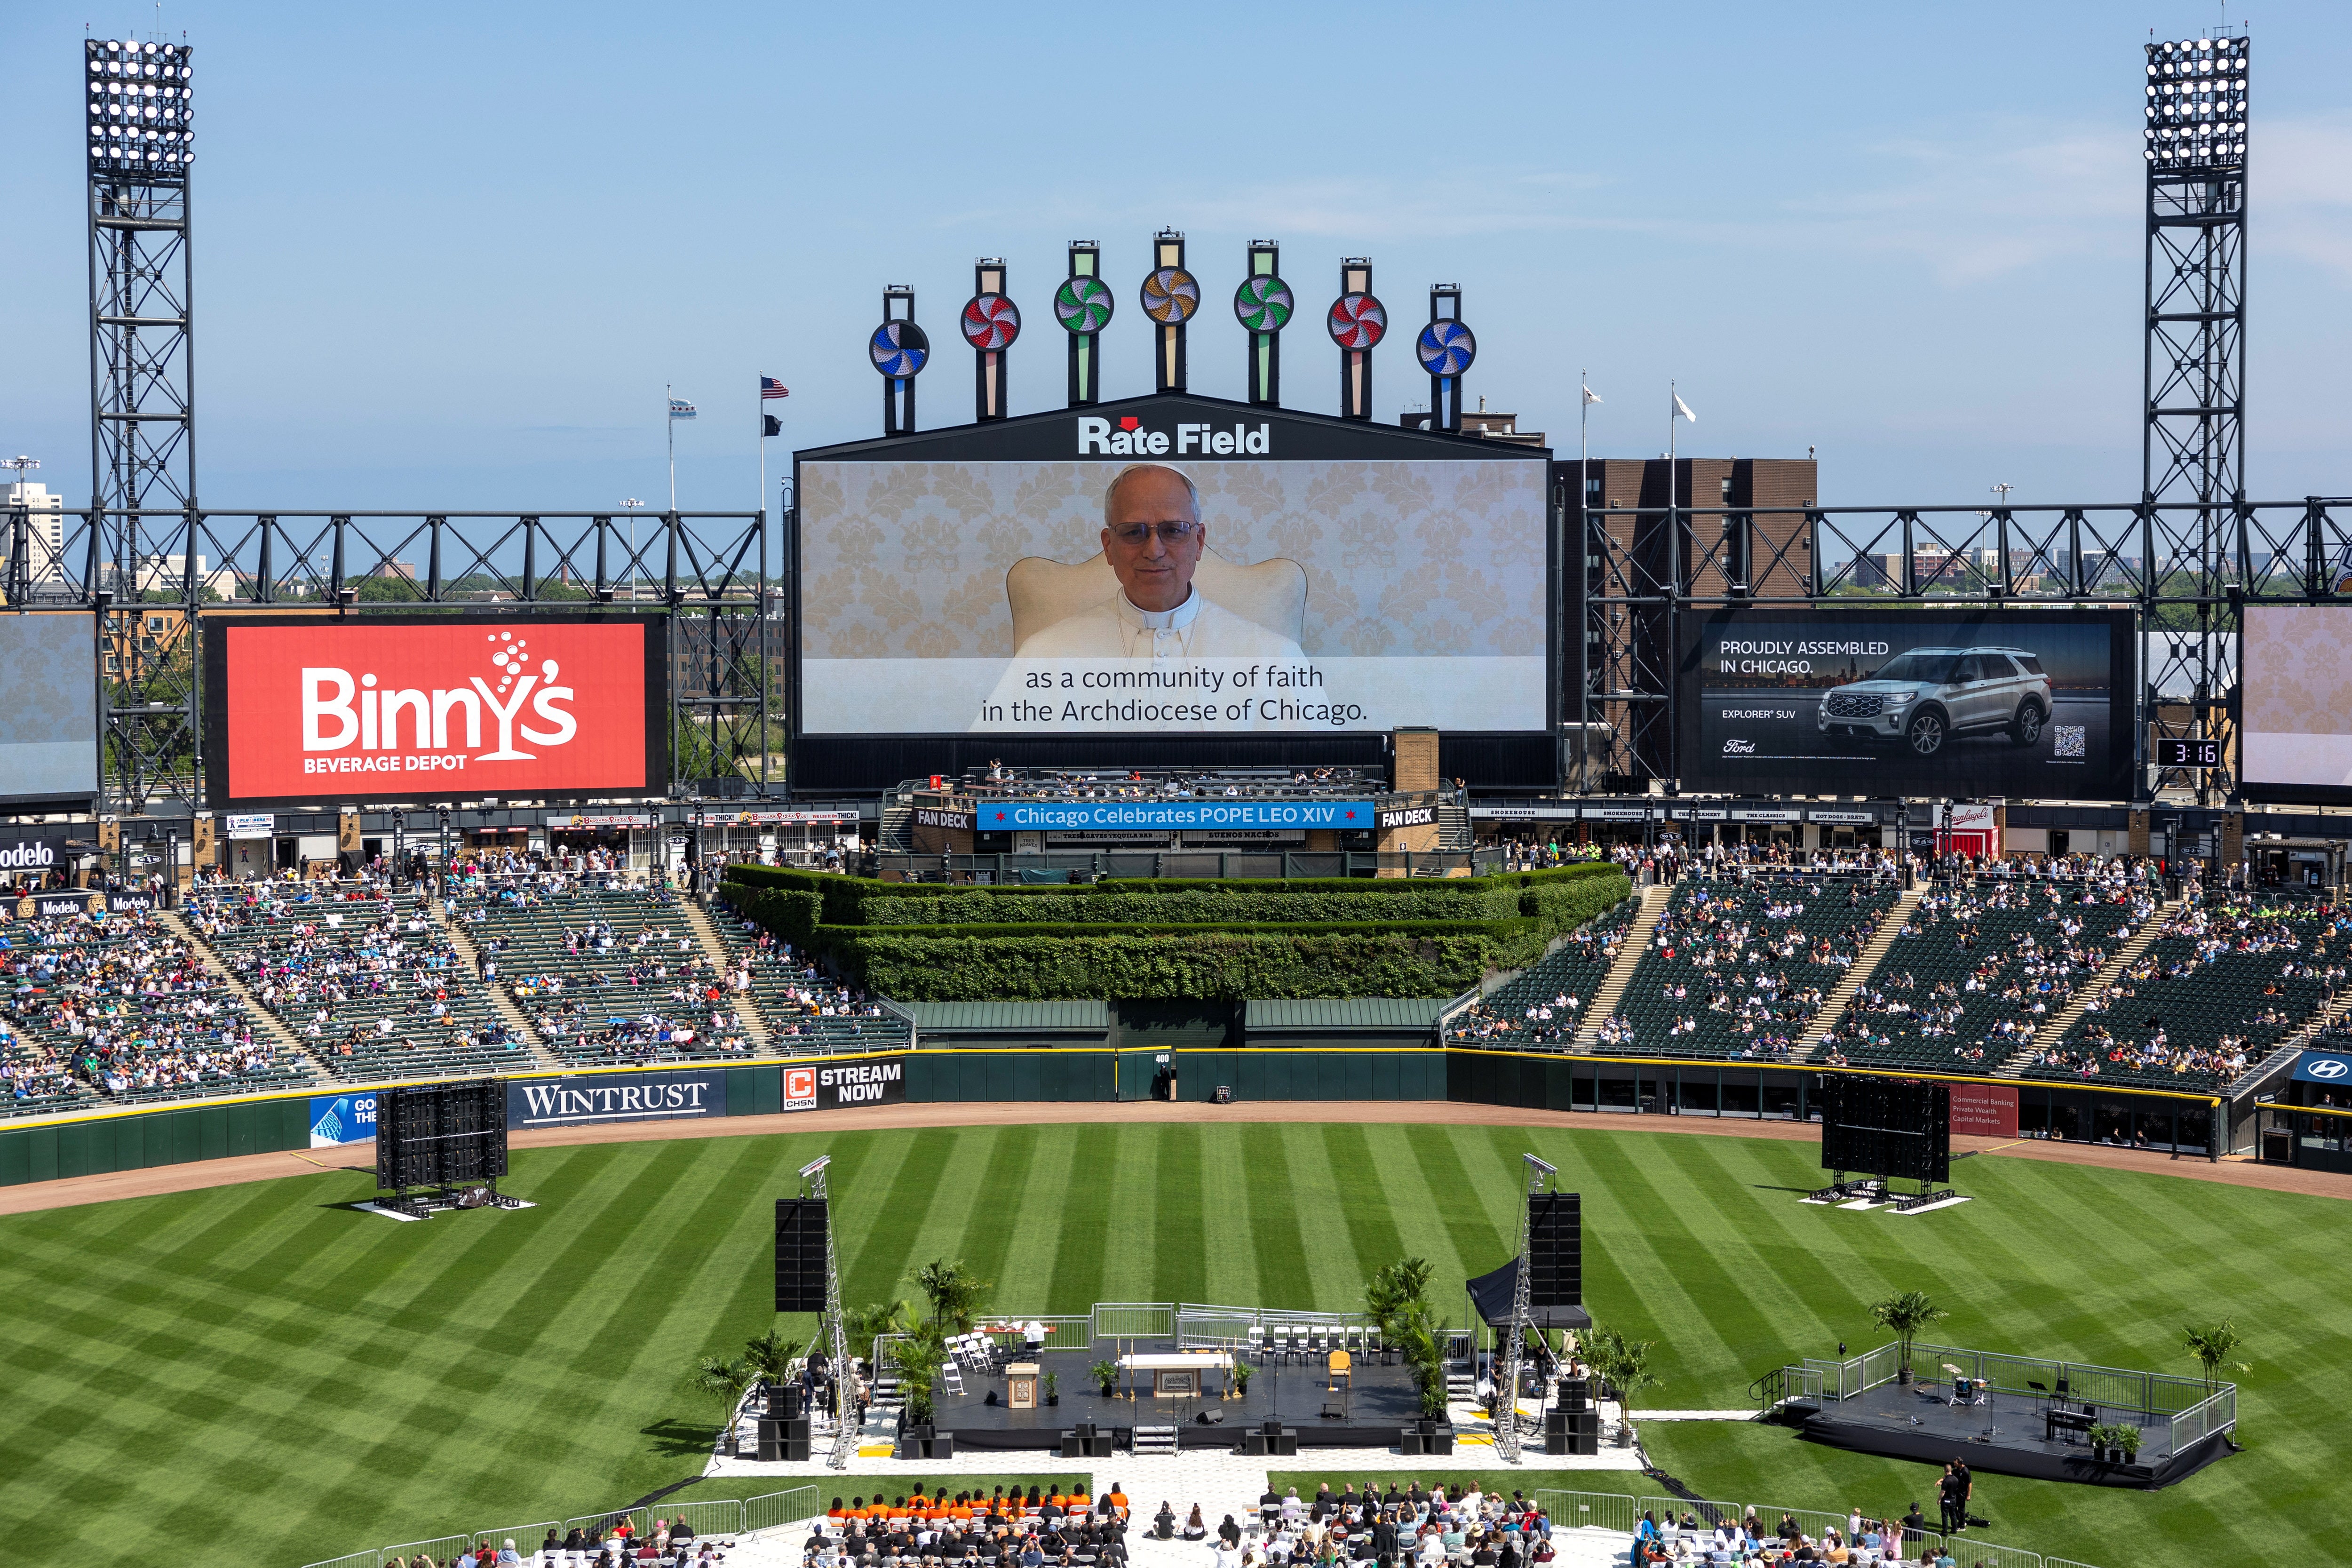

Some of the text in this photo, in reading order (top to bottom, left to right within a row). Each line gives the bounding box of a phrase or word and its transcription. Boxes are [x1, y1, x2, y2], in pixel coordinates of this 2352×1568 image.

[1078, 417, 1270, 455] Rate Field
[1720, 641, 1889, 655] PROUDLY ASSEMBLED
[1720, 660, 1813, 674] IN CHICAGO.
[1025, 665, 1323, 693] as a community of faith
[302, 659, 577, 761] Binny's
[982, 699, 1368, 726] in the Archdiocese of Chicago.
[1776, 710, 1796, 719] SUV
[1723, 739, 1756, 753] Ford
[2176, 744, 2216, 763] 3:16
[304, 755, 468, 774] BEVERAGE DEPOT
[918, 811, 968, 828] FAN DECK
[1015, 807, 1335, 828] Chicago Celebrates POPE LEO XIV
[1383, 808, 1432, 827] FAN DECK
[0, 841, 54, 868] odelo
[43, 901, 79, 915] Modelo
[113, 897, 150, 911] Modelo
[1156, 1054, 1169, 1063] 400
[820, 1064, 901, 1086] STREAM
[521, 1082, 707, 1117] WINTRUST
[839, 1082, 884, 1102] NOW
[1953, 1096, 2014, 1108] Commercial Banking
[1953, 1106, 1997, 1115] Private Wealth
[1953, 1115, 2001, 1125] Capital Markets
